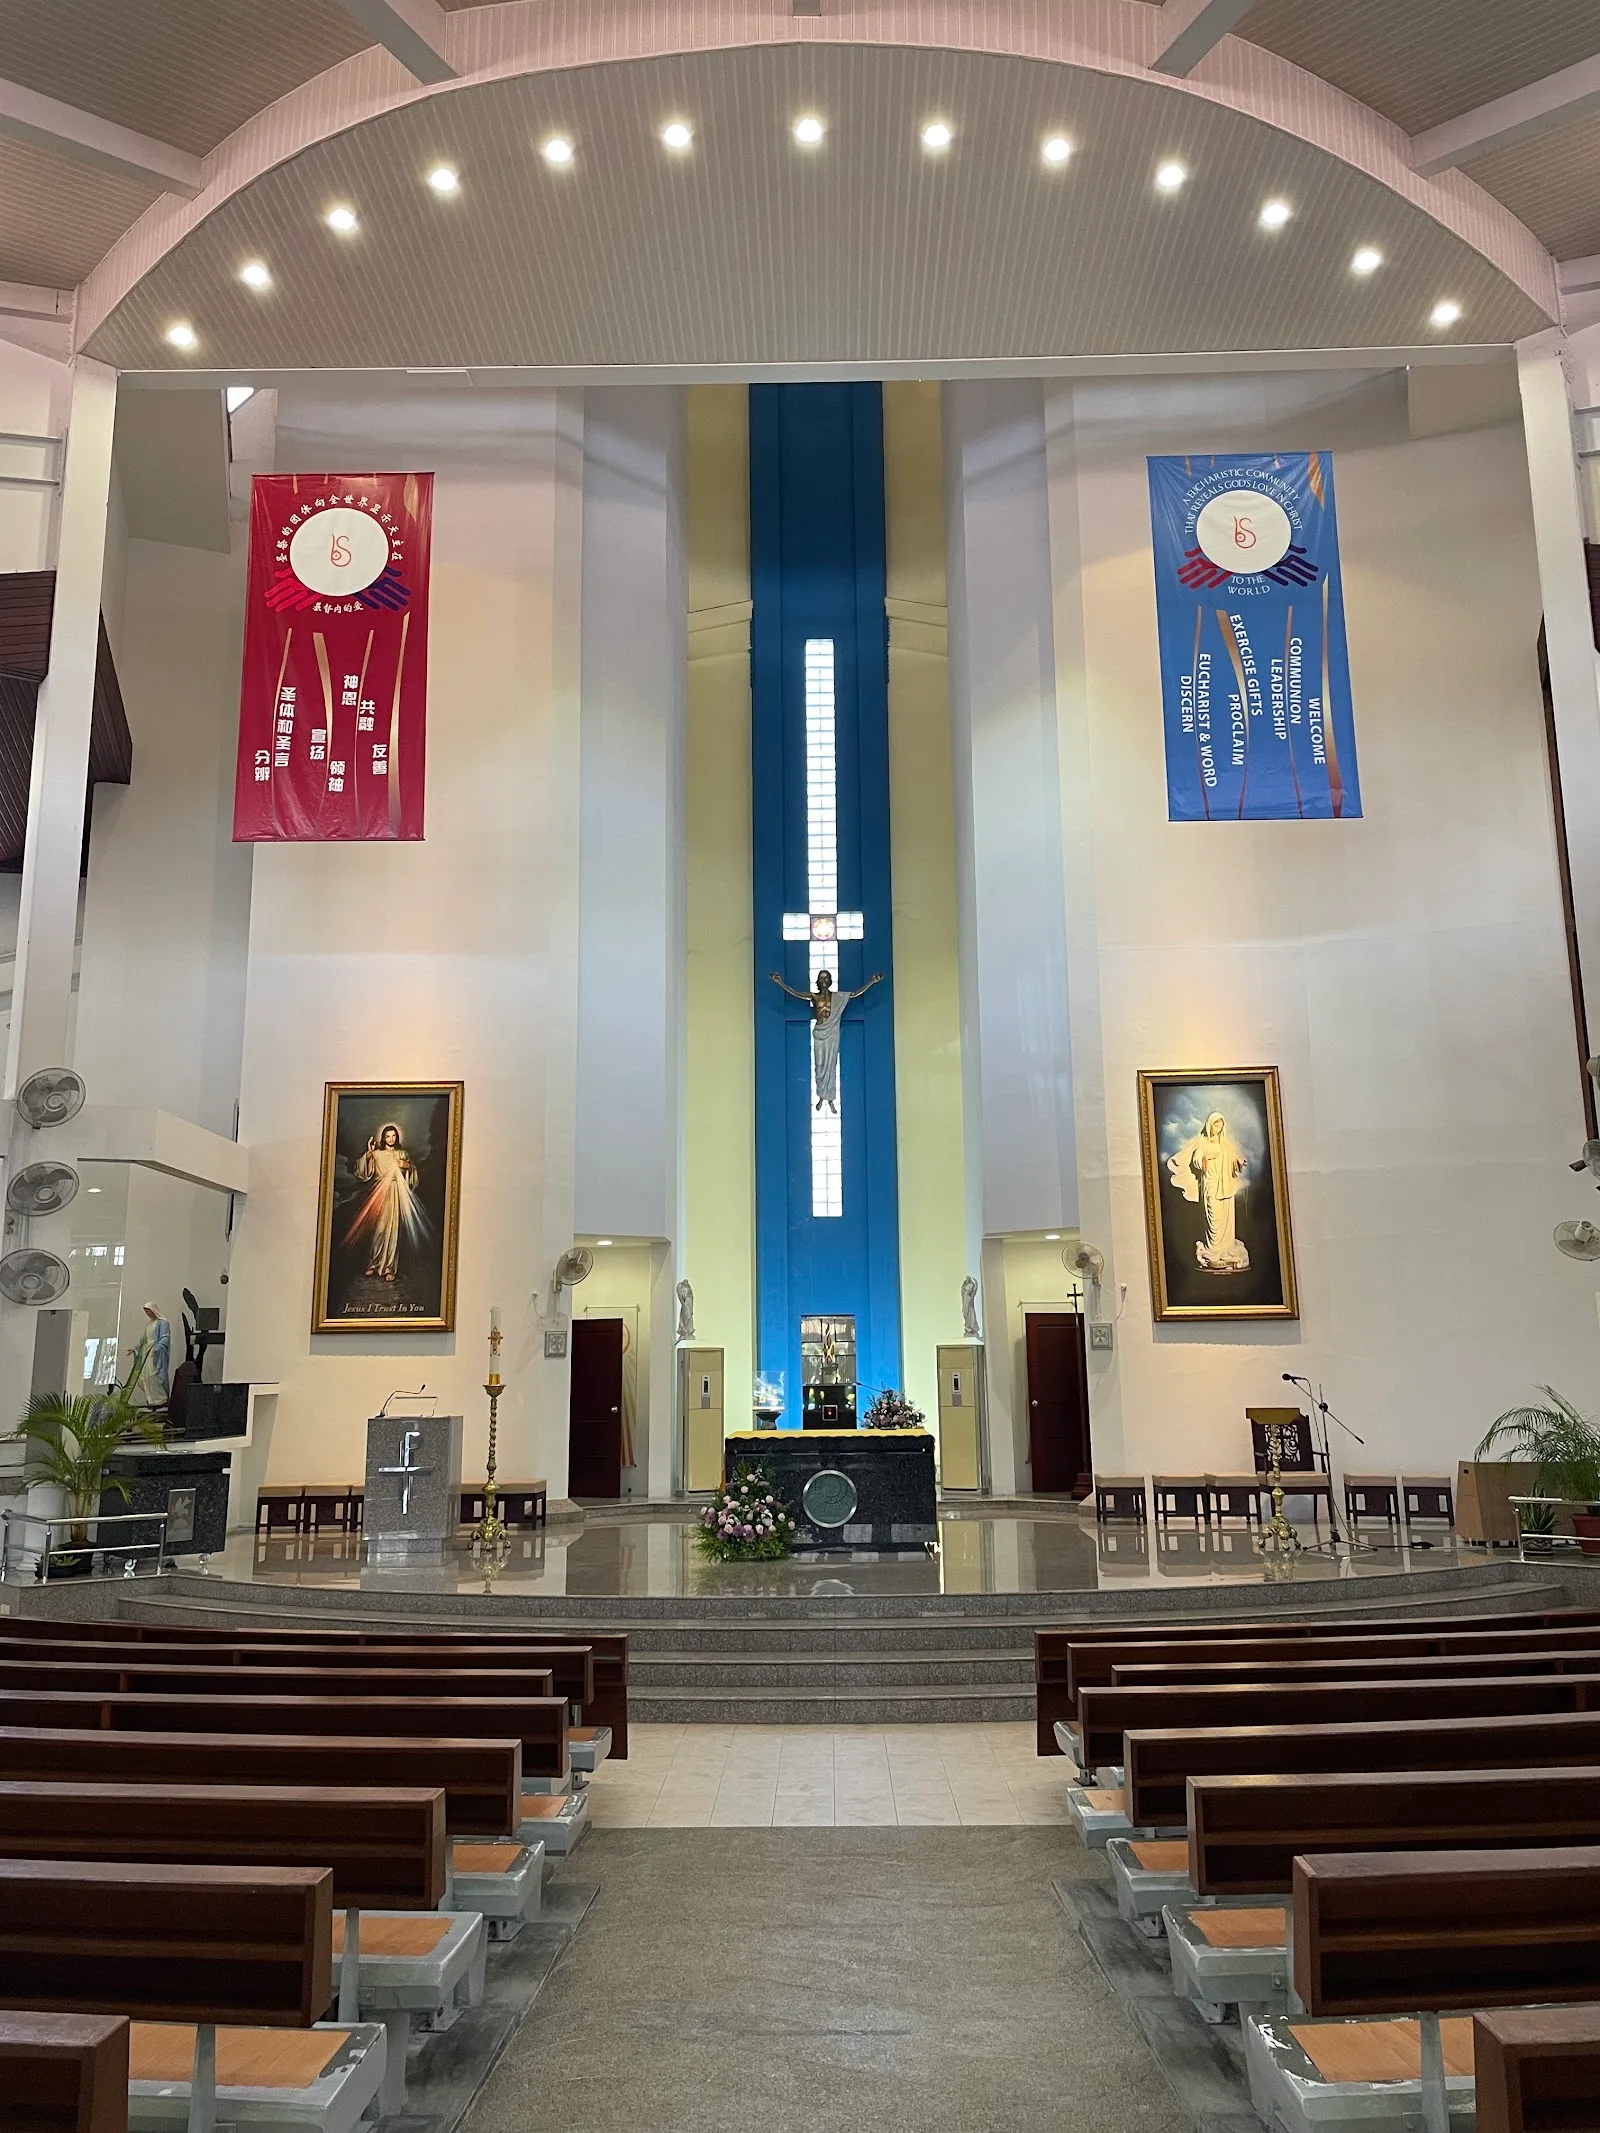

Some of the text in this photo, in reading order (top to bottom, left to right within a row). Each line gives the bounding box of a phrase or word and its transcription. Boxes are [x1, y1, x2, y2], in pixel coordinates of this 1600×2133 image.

[1182, 469, 1300, 505] A EUCHARISTIC COMMUNITY
[1184, 511, 1195, 534] THAT
[1190, 484, 1223, 512] REVEALS
[1252, 481, 1275, 496] LOVE
[1275, 492, 1286, 502] IN
[1283, 501, 1302, 530] CHRIST
[1227, 584, 1270, 595] WORLD
[1231, 574, 1265, 584] TO THE
[1229, 614, 1263, 716] EXERCISE GIFTS
[1289, 637, 1302, 724] COMMUNION
[341, 675, 359, 706] 神恩
[1180, 675, 1194, 733] DISCERN
[1270, 659, 1287, 740] LEADERSHIP
[274, 687, 296, 767] 圣体和圣言
[358, 701, 375, 731] 共融
[1197, 653, 1217, 787] EUCHARIST & WORD
[1227, 694, 1244, 765] PROCLAIM
[1308, 698, 1325, 765] WELCOME
[309, 729, 326, 760] 宣扬
[371, 744, 387, 775] 友善
[254, 750, 270, 781] 分辨
[327, 761, 345, 792] 领袖
[343, 1303, 424, 1313] Jesus I Trust In You
